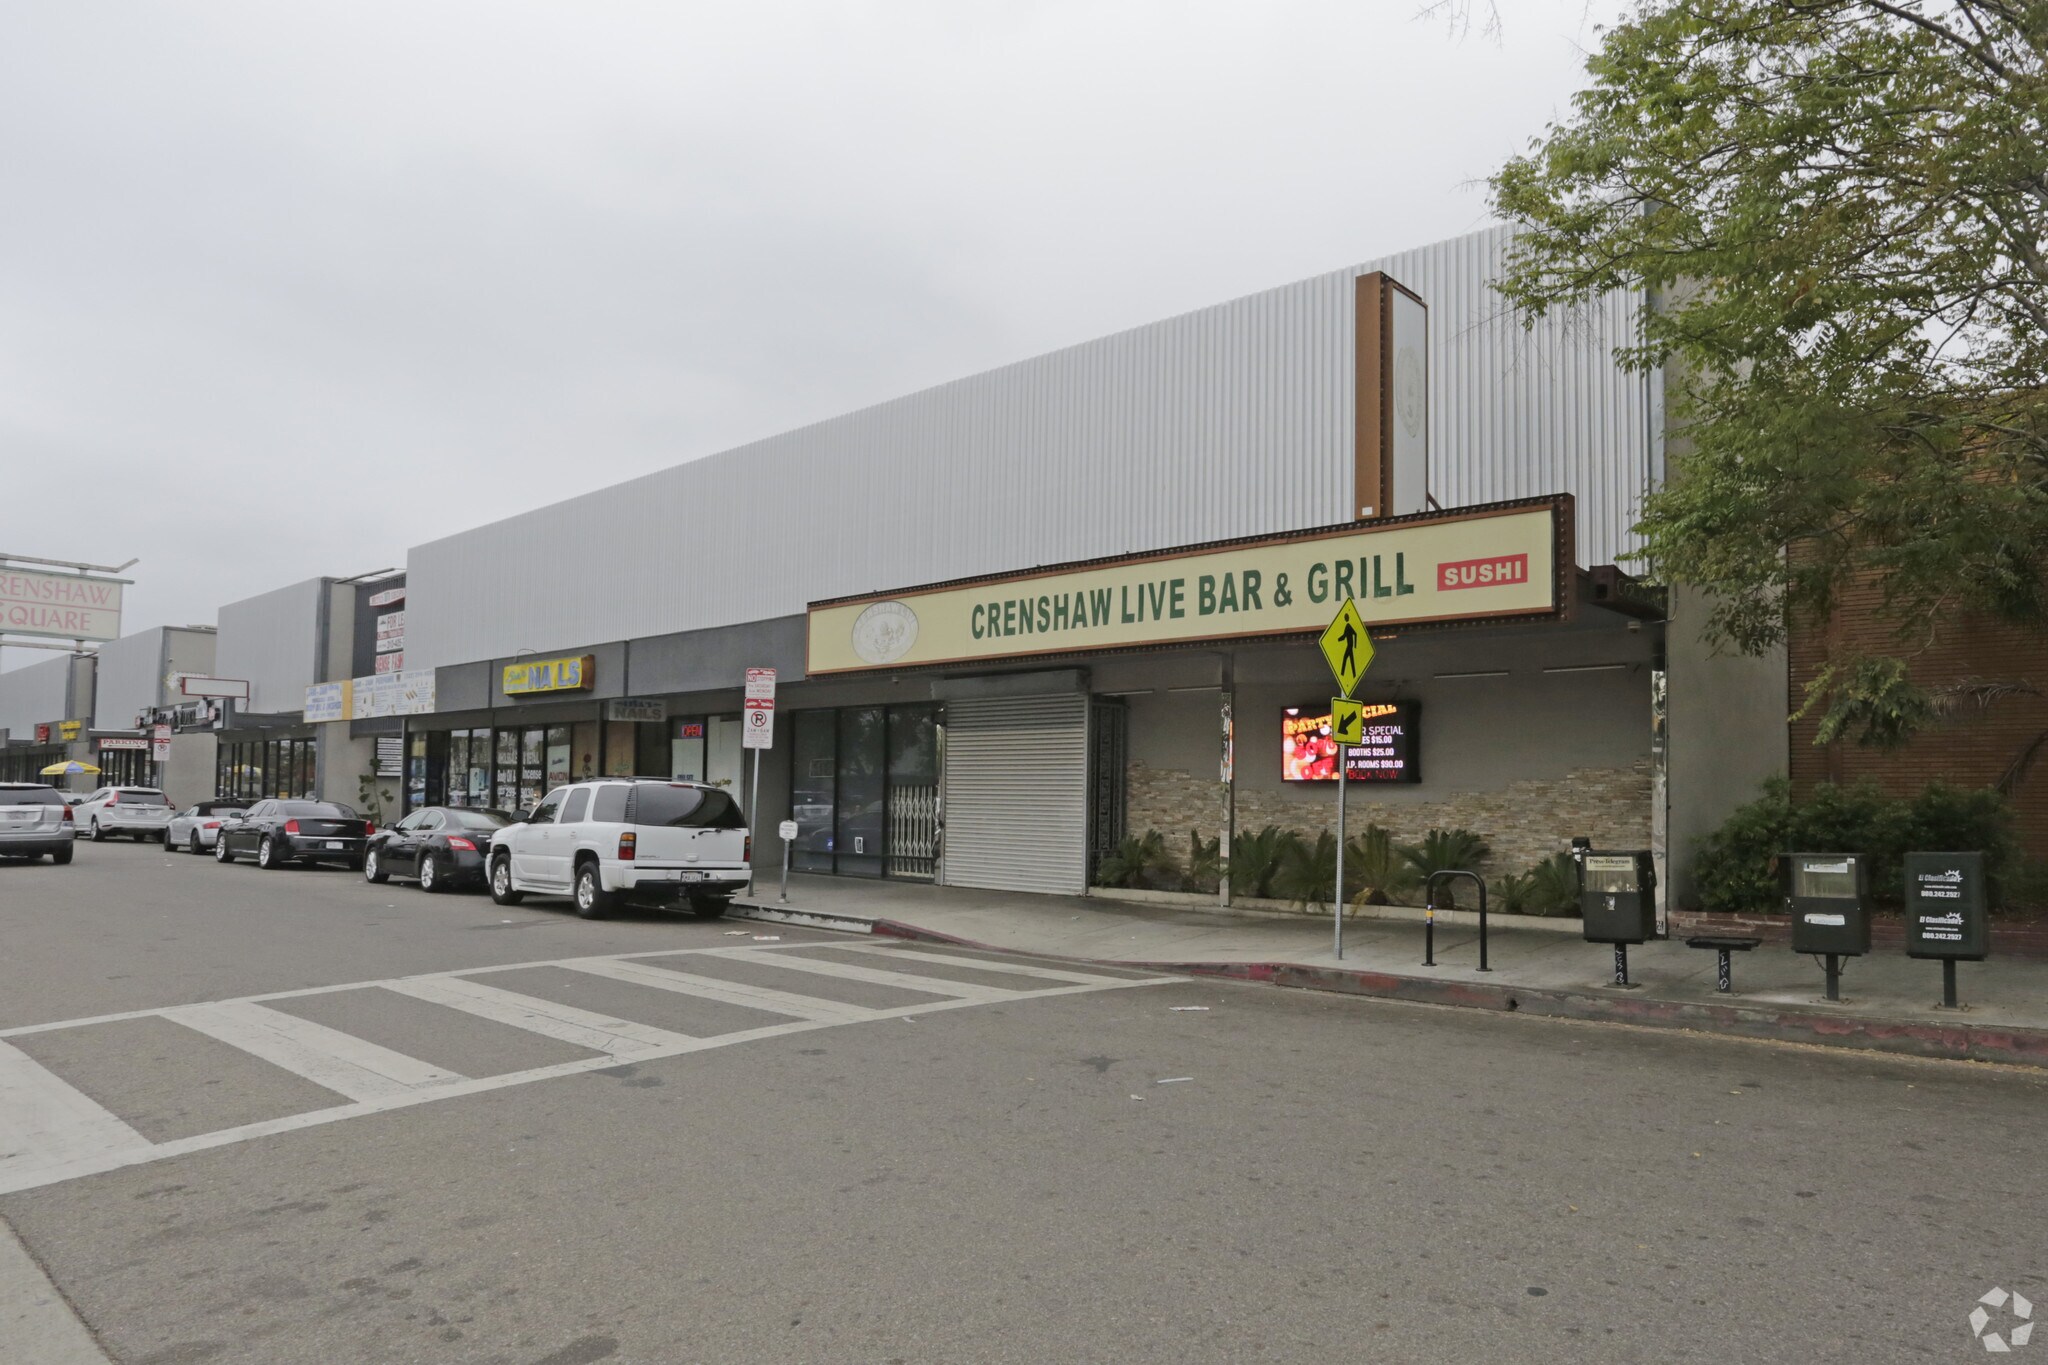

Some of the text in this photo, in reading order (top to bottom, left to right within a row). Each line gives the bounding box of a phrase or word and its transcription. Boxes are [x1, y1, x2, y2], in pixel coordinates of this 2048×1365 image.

[1444, 560, 1522, 587] SUSHI
[971, 552, 1415, 640] CRENSHAW LIVE BAR & GRILL
[528, 661, 580, 690] NALS
[747, 674, 757, 682] NO
[614, 707, 661, 720] NAILS
[1287, 704, 1397, 735] PARTY CIAL
[682, 724, 703, 737] OPEN
[1369, 725, 1404, 736] SPECIAL
[1371, 735, 1393, 745] $15.00
[1348, 747, 1395, 757] BOOTHS $25.00
[1358, 760, 1380, 769] ROOMS
[1381, 760, 1404, 769] $90.00
[549, 771, 569, 782] AVON
[1348, 769, 1399, 780] BOOK NOW
[1924, 874, 1958, 882] Clasificado
[1925, 916, 1959, 924] Clasificado
